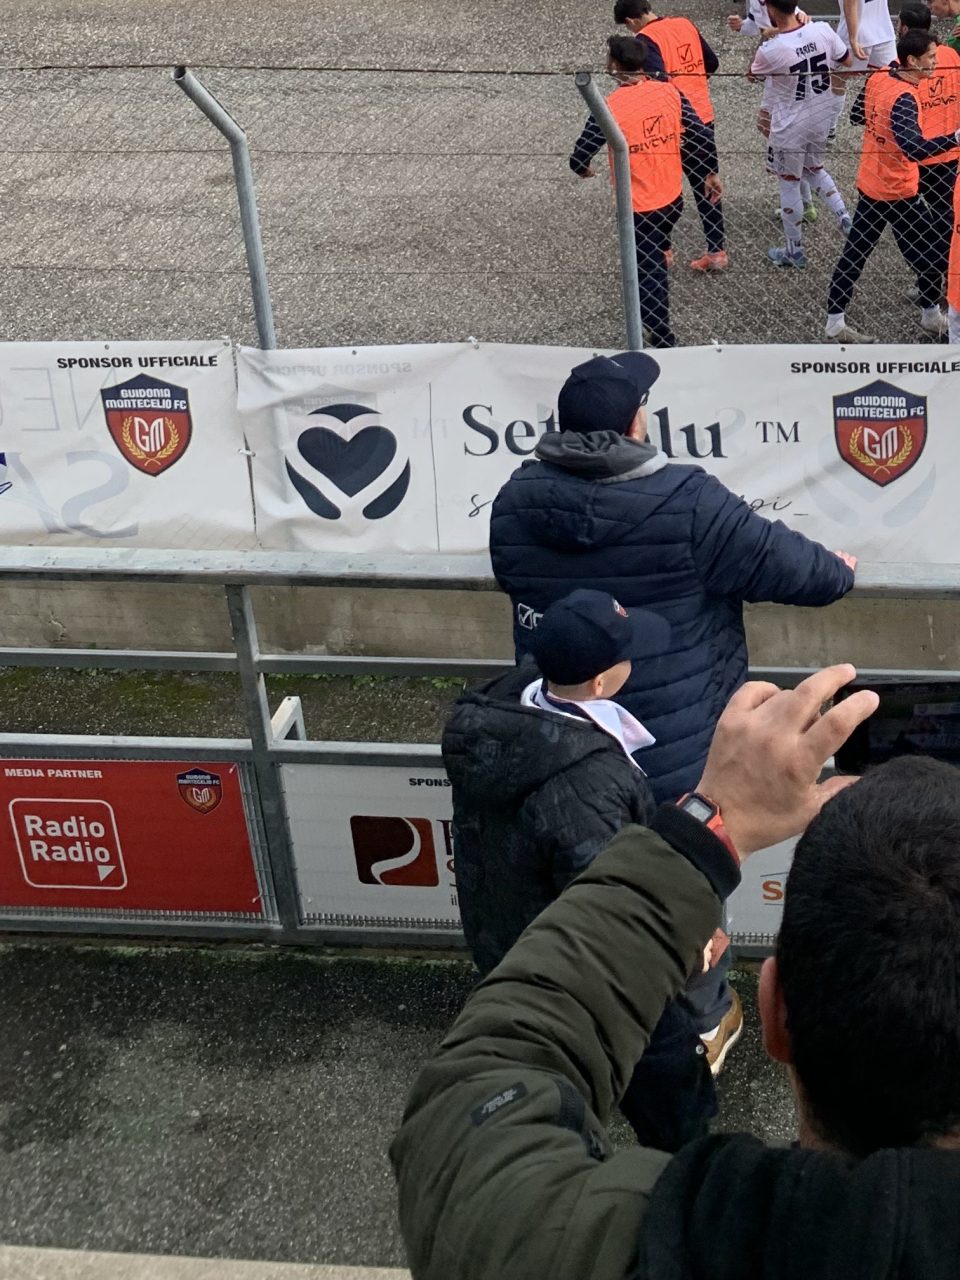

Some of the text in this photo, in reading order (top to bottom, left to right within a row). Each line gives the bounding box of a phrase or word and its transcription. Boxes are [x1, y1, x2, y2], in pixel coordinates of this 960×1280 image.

[789, 52, 830, 101] 75
[57, 356, 218, 369] SPONSOR UFFICIALE
[790, 361, 960, 374] SPONSOR UFFICIALE
[120, 388, 171, 398] GUIDONIA
[105, 399, 187, 410] MONTECELIO FC
[854, 396, 906, 407] GUIDONIA
[836, 406, 924, 418] MONTECELIO FC
[756, 421, 800, 443] TM
[4, 768, 103, 779] MEDIA PARTNER
[409, 778, 452, 787] SPONS
[24, 814, 105, 839] Radio
[30, 839, 111, 863] Radio
